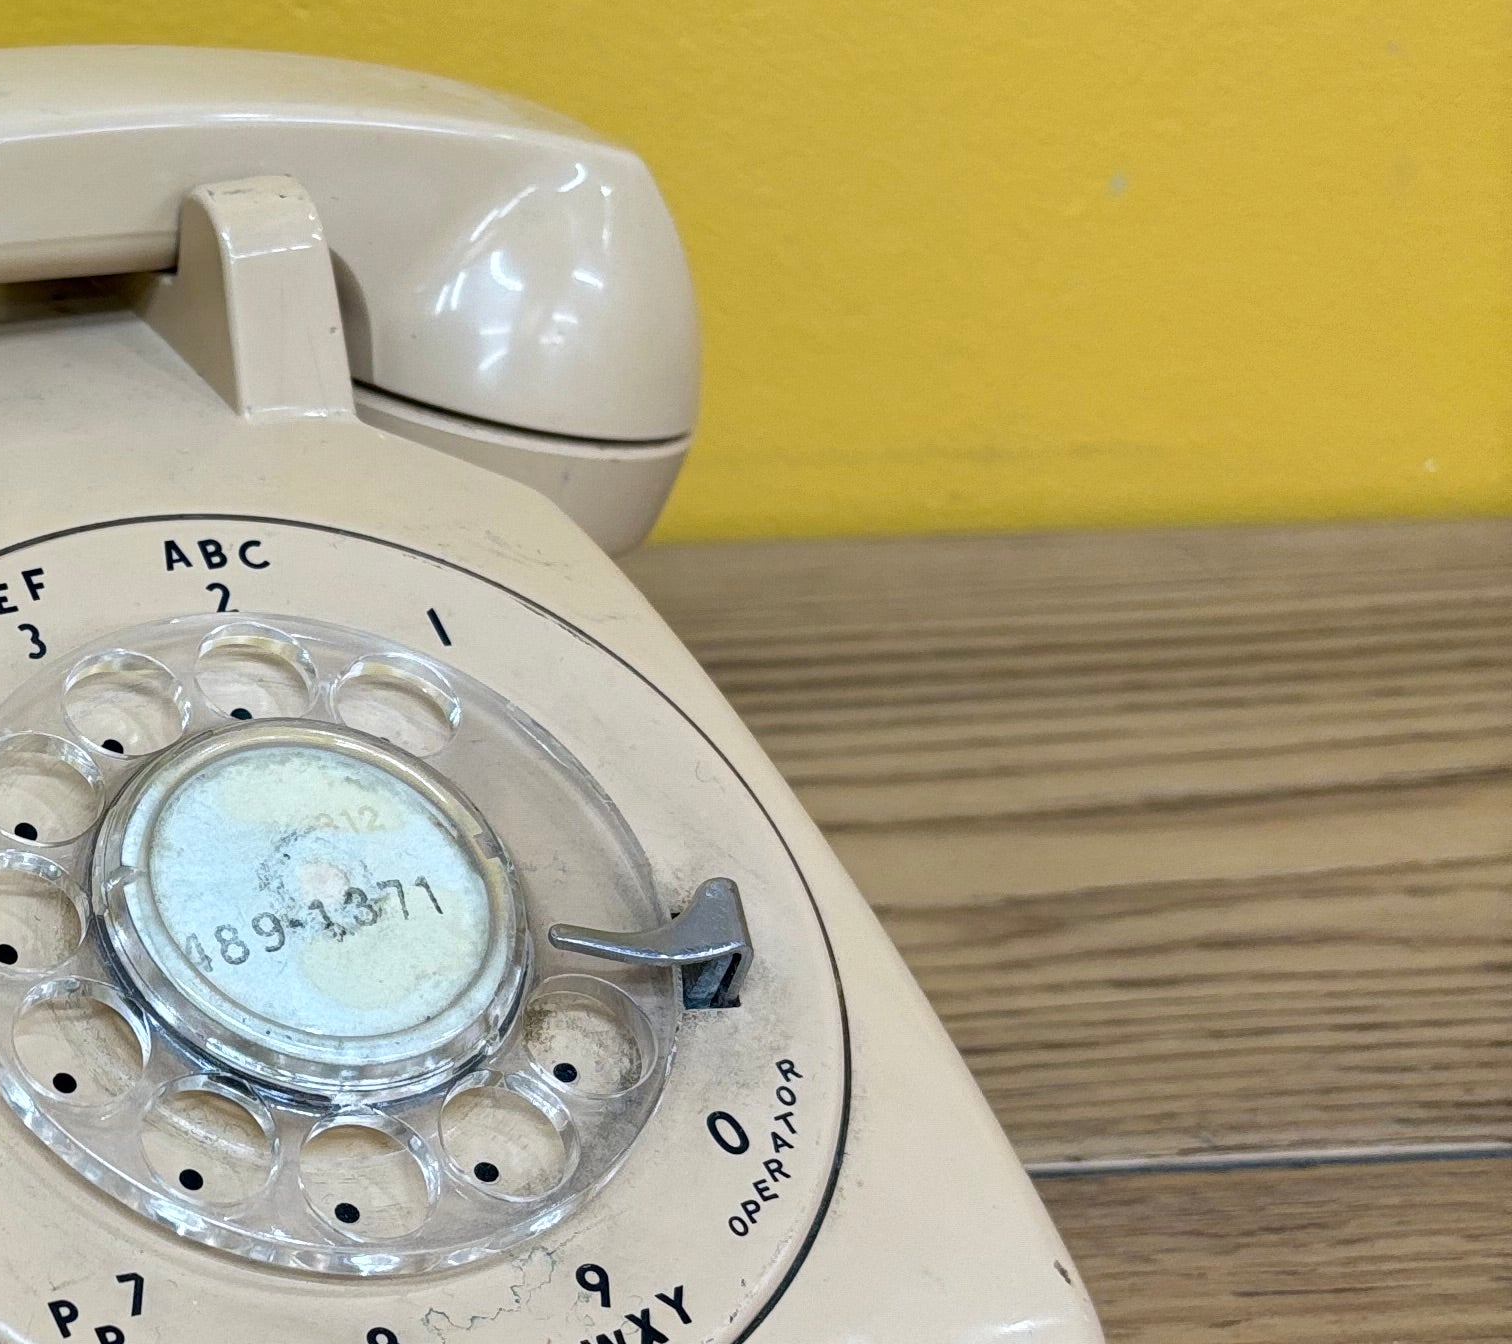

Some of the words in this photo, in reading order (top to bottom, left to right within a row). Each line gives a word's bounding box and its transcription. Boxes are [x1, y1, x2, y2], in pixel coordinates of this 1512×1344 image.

[164, 539, 271, 572] ABC
[205, 582, 239, 613] 2
[17, 623, 48, 660] 3
[727, 1058, 804, 1237] OPERATOR
[115, 1272, 145, 1317] 7
[575, 1263, 612, 1309] 9
